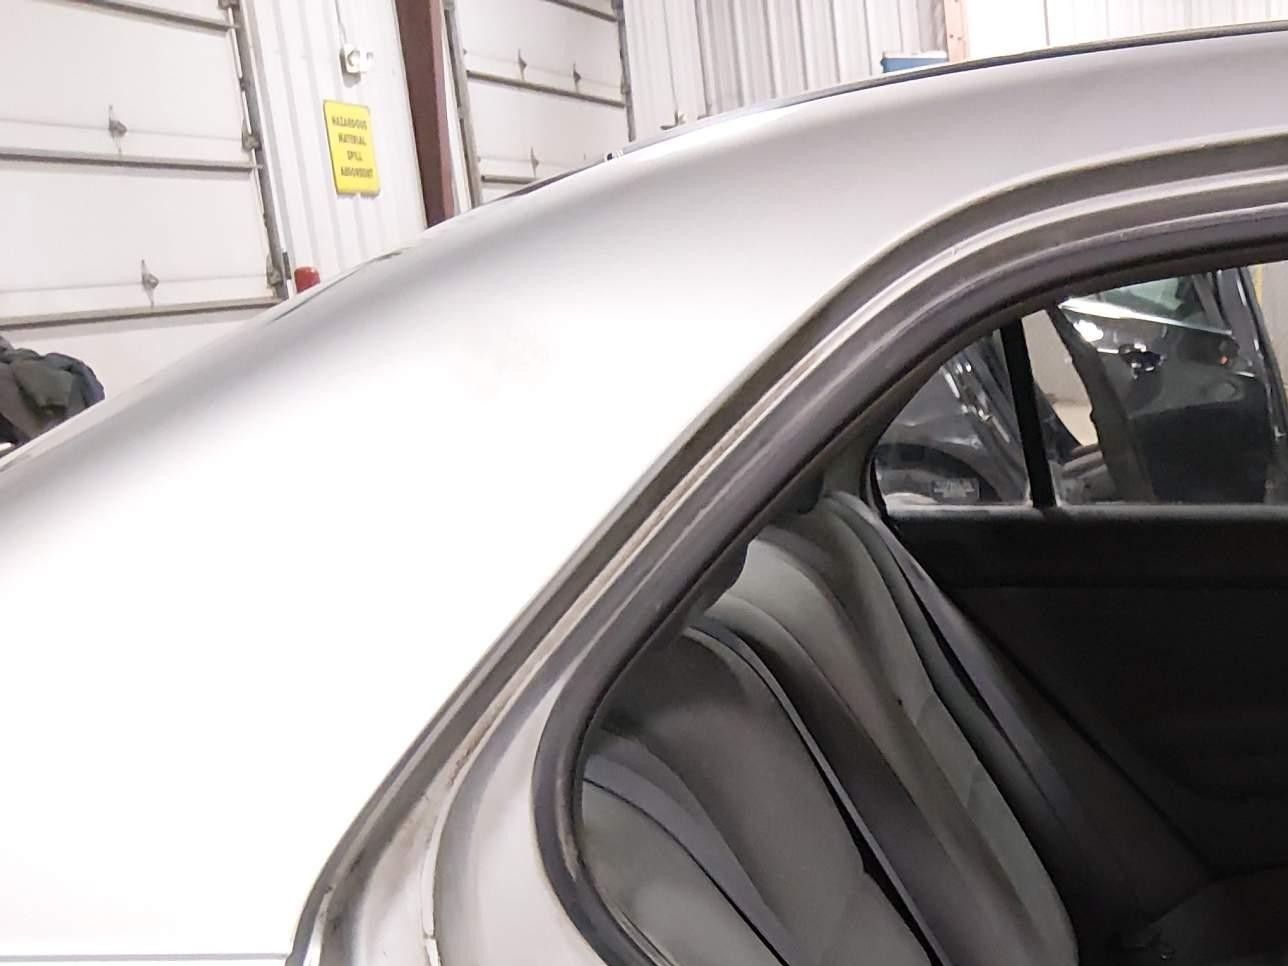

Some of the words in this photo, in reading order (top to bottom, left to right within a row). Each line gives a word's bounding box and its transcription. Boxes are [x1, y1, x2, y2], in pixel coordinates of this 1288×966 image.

[331, 116, 368, 131] HAZARDOUS
[338, 132, 367, 146] MATERIAL
[347, 150, 363, 162] SPILL
